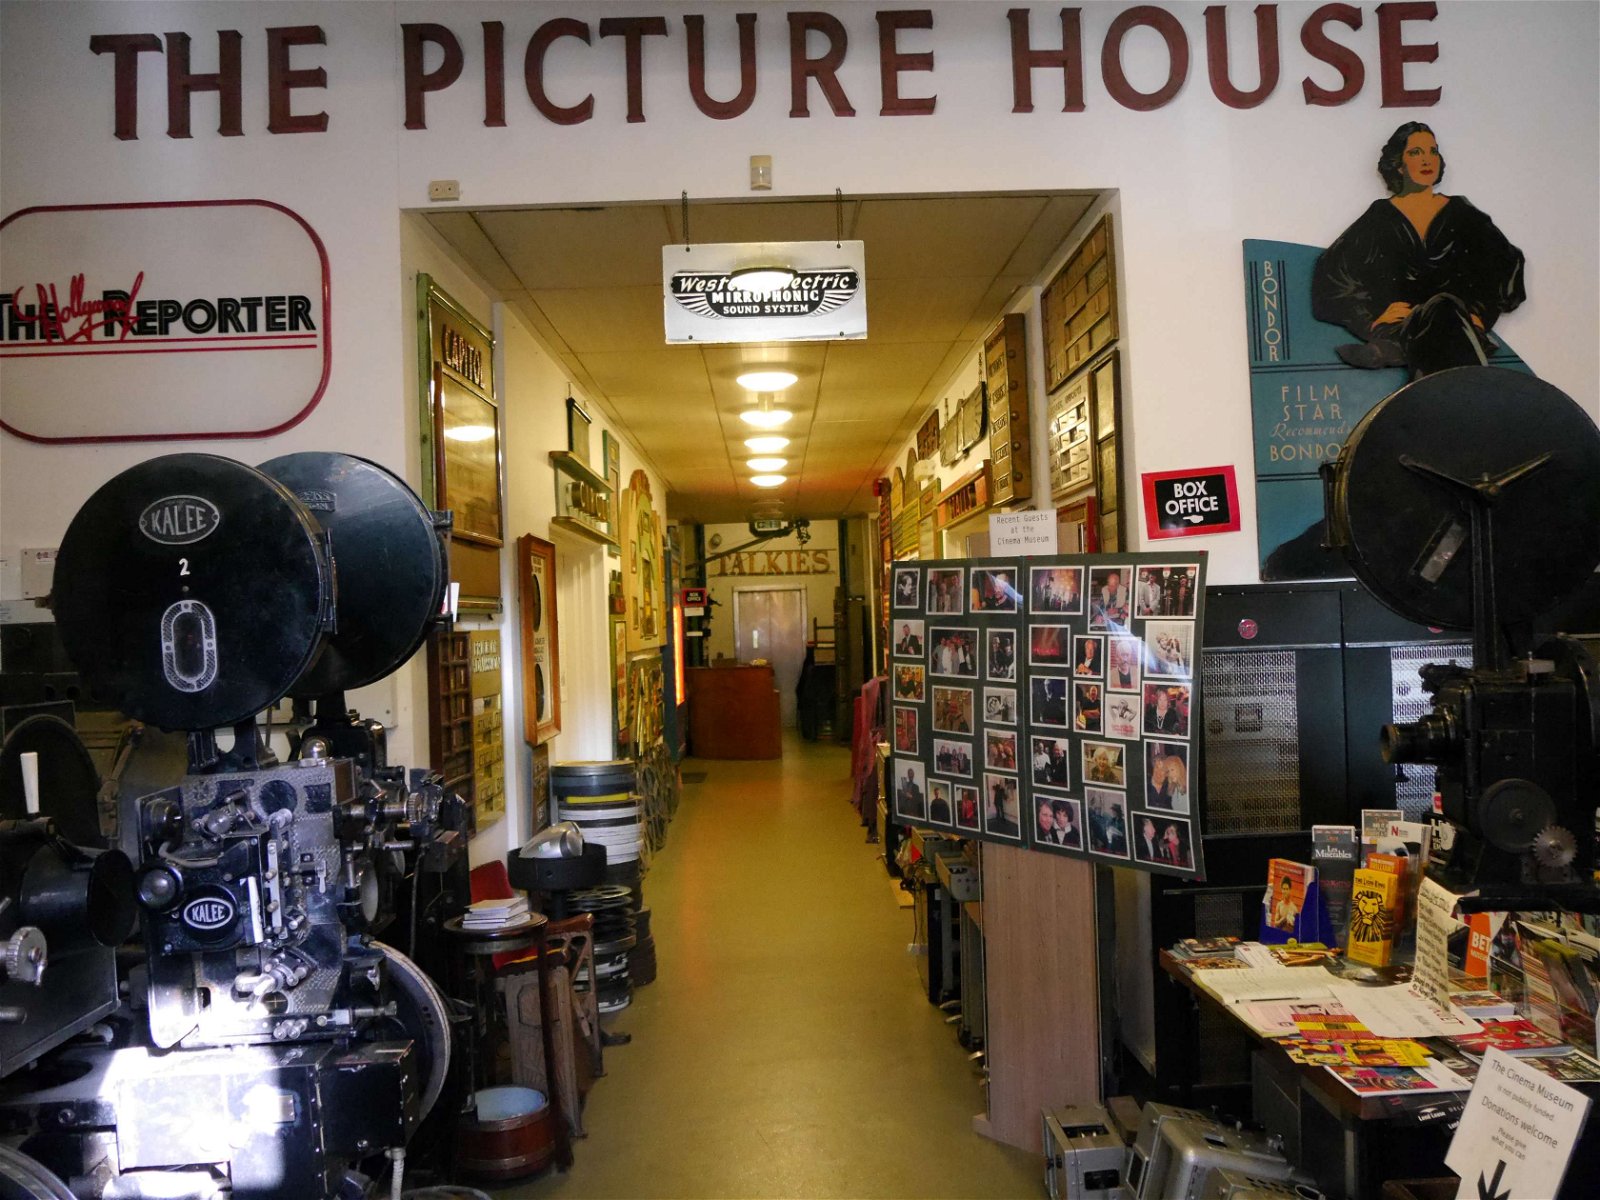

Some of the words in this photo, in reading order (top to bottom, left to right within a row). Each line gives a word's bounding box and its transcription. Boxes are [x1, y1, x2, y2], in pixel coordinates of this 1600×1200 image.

[89, 25, 328, 140] THE
[401, 10, 936, 130] PICTURE
[1006, 1, 1442, 114] HOUSE
[12, 271, 144, 344] Hollywood
[102, 290, 317, 336] REPORTER
[723, 305, 760, 315] SOUND
[765, 304, 809, 314] SYSTEM
[1262, 260, 1282, 362] BONDOR
[441, 324, 486, 390] CAPITOL
[1282, 384, 1340, 402] FILM
[1284, 404, 1342, 421] STAR
[1271, 443, 1341, 461] BONDO
[1173, 481, 1208, 498] BOX
[1165, 496, 1219, 515] OFFICE
[151, 505, 207, 535] KALEE
[996, 515, 1020, 524] Recent
[1023, 514, 1048, 522] Guests
[1011, 526, 1018, 534] at
[997, 537, 1020, 545] Cinema
[1024, 536, 1049, 544] Museum
[178, 558, 191, 576] 2
[717, 551, 830, 575] TALKIES
[192, 904, 225, 922] KALEE
[1492, 1059, 1506, 1075] The
[1506, 1068, 1535, 1091] Cinema
[1536, 1084, 1574, 1112] Museum
[1502, 1087, 1512, 1097] not
[1511, 1092, 1533, 1109] publicly
[1482, 1095, 1519, 1126] Donations
[1520, 1121, 1558, 1149] welcome
[1491, 1135, 1506, 1150] what
[1504, 1144, 1515, 1155] you
[1515, 1149, 1526, 1161] can
[1498, 1127, 1514, 1143] Please
[1514, 1138, 1527, 1151] give
